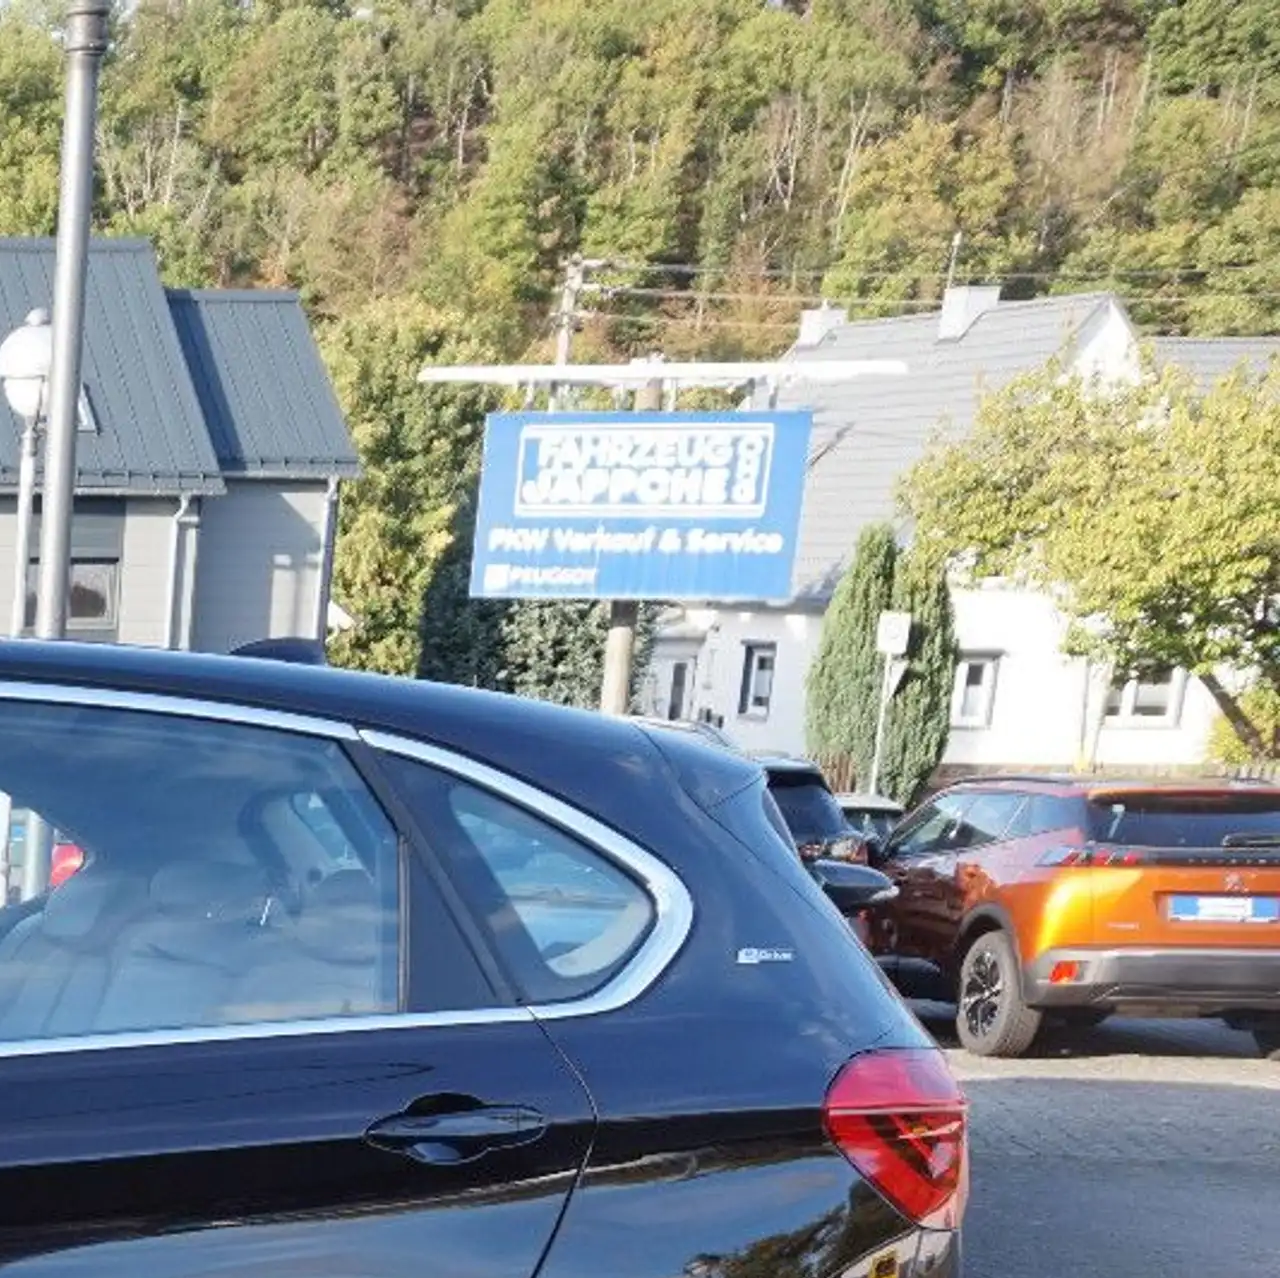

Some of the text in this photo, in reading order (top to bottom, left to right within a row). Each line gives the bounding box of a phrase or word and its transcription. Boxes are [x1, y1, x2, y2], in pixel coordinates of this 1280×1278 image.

[537, 432, 734, 467] FAHRZEUG
[488, 525, 784, 554] PKW Verkauf & Service
